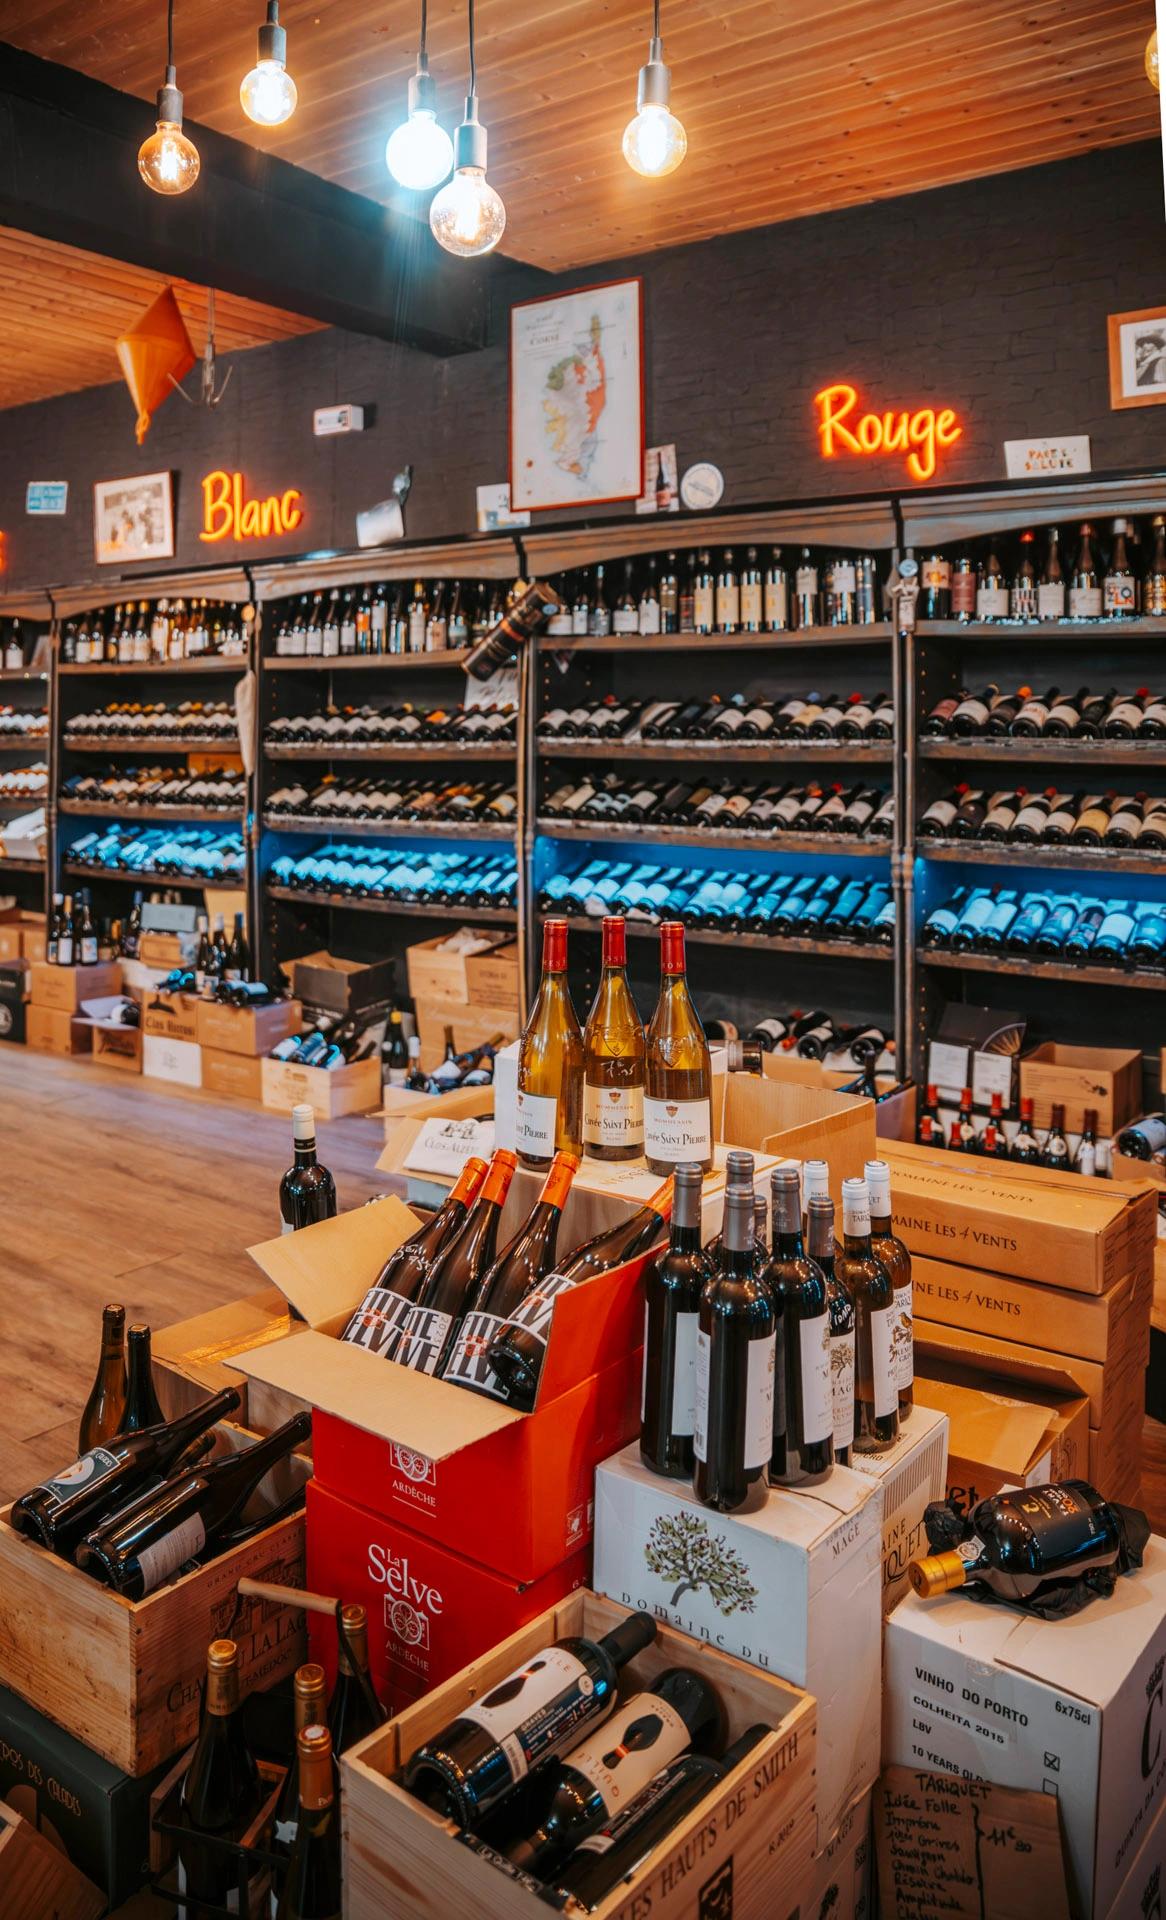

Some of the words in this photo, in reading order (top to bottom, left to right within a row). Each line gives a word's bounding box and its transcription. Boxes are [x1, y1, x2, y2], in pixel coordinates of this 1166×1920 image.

[815, 384, 963, 480] Rouge
[200, 470, 301, 542] Blanc
[891, 1215, 932, 1233] MAINE
[935, 1223, 957, 1239] LES
[959, 1227, 971, 1241] 4
[972, 1231, 1018, 1252] VENTS
[938, 1287, 960, 1302] LES
[962, 1290, 974, 1304] 4
[976, 1294, 1022, 1317] VENTS
[392, 1479, 437, 1507] ARDÈCHE
[832, 1524, 861, 1560] MAGE
[882, 1517, 906, 1553] AINE
[387, 1548, 401, 1566] La
[882, 1522, 924, 1588] IQUET
[367, 1543, 444, 1616] Selve
[914, 1666, 954, 1694] VINHO
[962, 1688, 980, 1706] DO
[984, 1698, 1028, 1727] PORTO
[1055, 1700, 1091, 1726] 6x75cl
[912, 1718, 932, 1735] LBV
[913, 1695, 971, 1729] COLHEITA
[975, 1723, 1005, 1744] 2015
[912, 1744, 924, 1758] 10
[926, 1751, 960, 1775] YEARS
[661, 1817, 717, 1898] HAUTS
[725, 1787, 747, 1832] DE
[753, 1731, 799, 1799] SMITH
[884, 1790, 921, 1811] Idée
[926, 1799, 961, 1815] Folle
